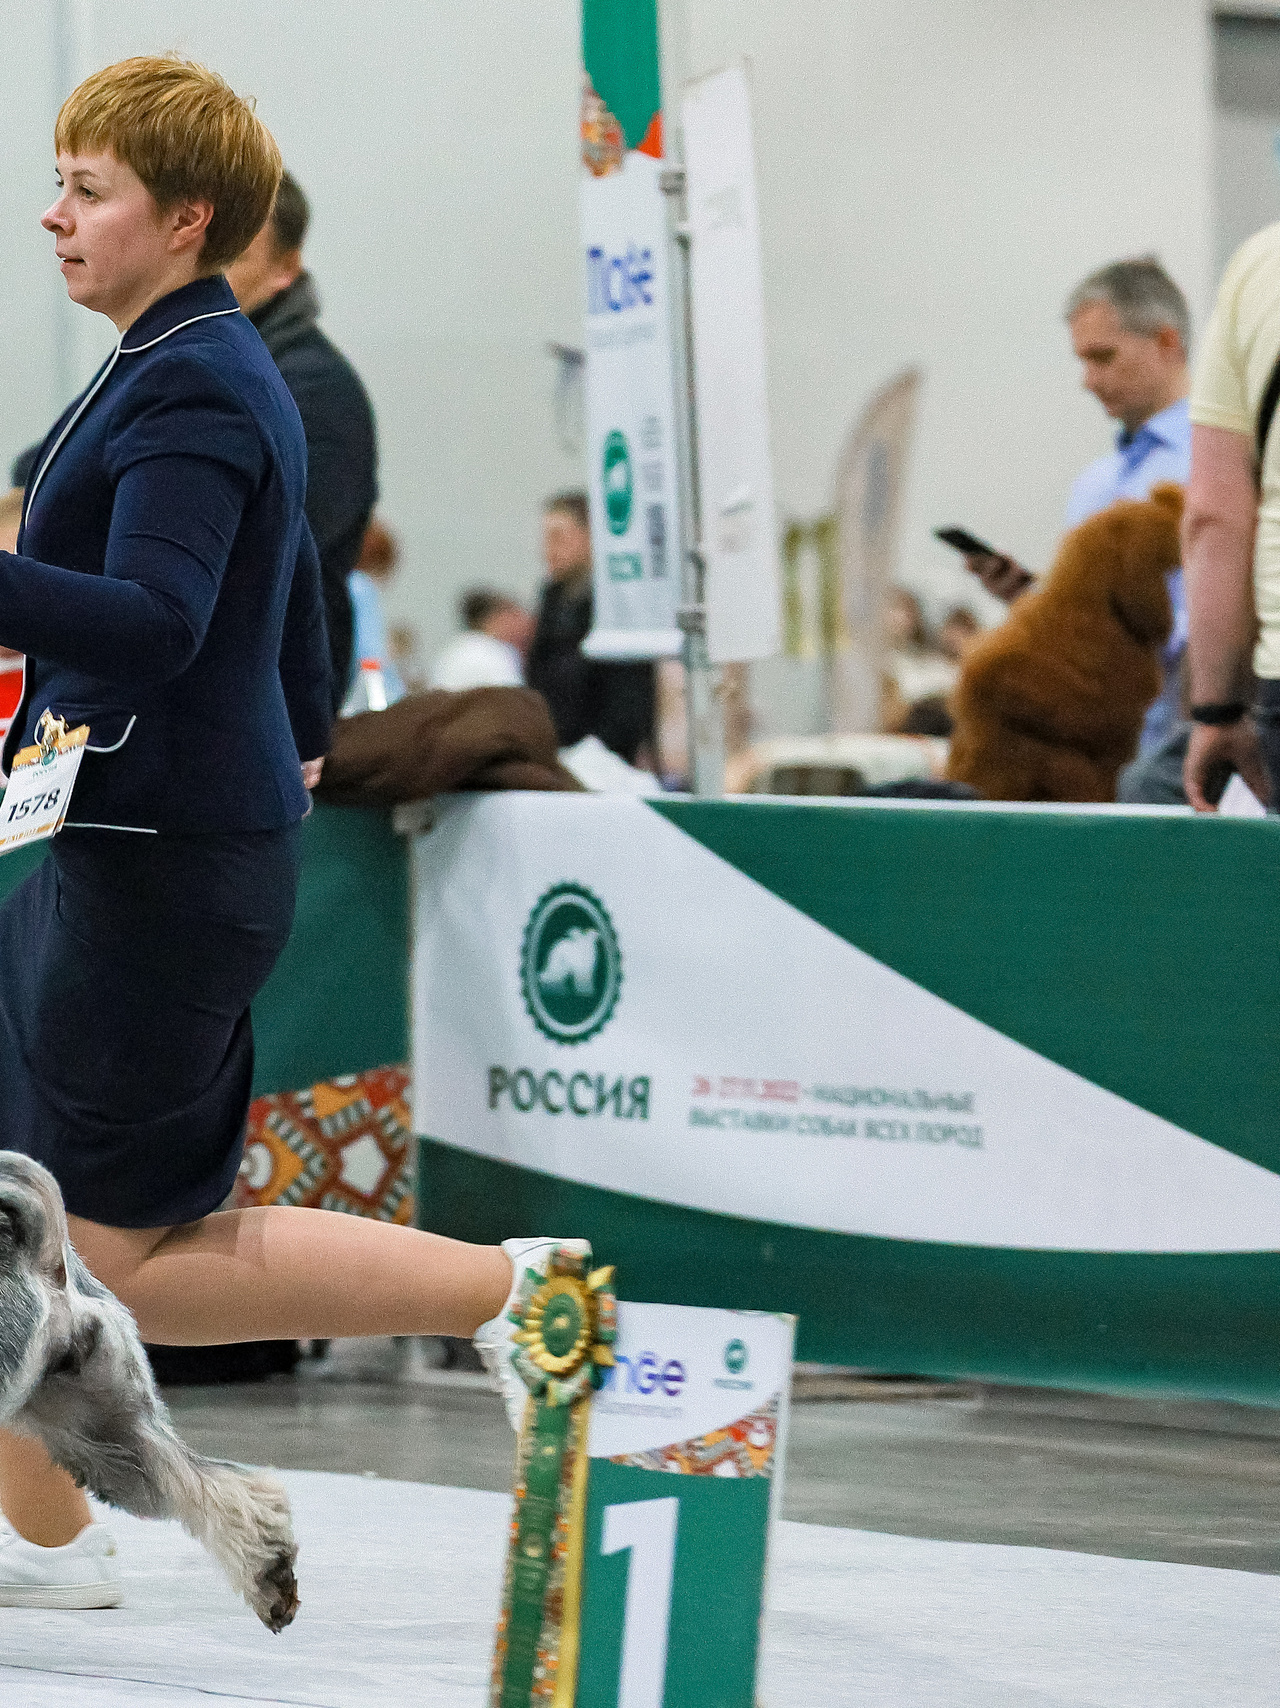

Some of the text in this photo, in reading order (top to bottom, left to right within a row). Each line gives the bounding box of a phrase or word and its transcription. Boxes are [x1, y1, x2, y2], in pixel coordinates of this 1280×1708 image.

[7, 787, 61, 823] 1578
[488, 1065, 653, 1122] РОССИЯ
[601, 1497, 680, 1708] 1
